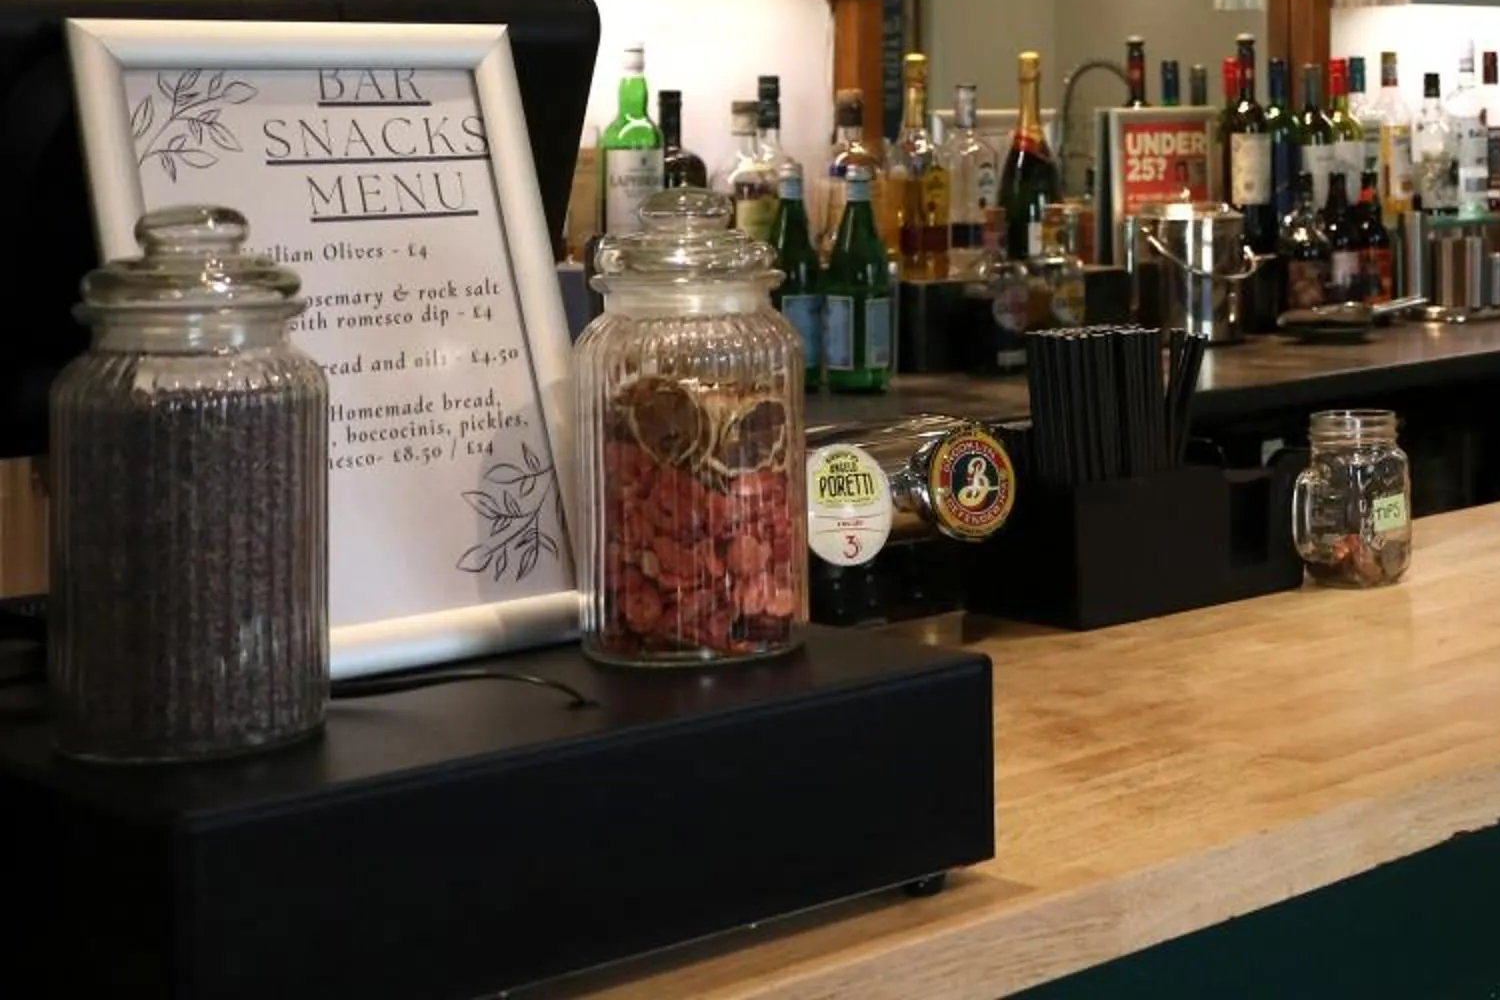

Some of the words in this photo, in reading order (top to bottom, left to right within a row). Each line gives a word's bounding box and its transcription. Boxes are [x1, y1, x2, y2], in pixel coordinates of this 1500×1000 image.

[317, 67, 424, 103] BAR
[262, 115, 490, 160] SNACKS
[1125, 131, 1207, 157] UNDER
[1126, 156, 1168, 182] 25?
[306, 170, 466, 215] MENU
[322, 242, 384, 261] Olives
[407, 244, 428, 262] £4
[306, 288, 384, 311] osemary
[392, 283, 410, 302] &
[418, 279, 458, 300] rock
[465, 276, 501, 297] salt
[336, 310, 414, 328] romesco
[420, 303, 450, 328] dip
[472, 306, 493, 323] £4
[321, 354, 362, 377] ead
[370, 351, 406, 373] and
[471, 346, 519, 368] £4.50
[330, 394, 434, 423] Homemade
[329, 453, 384, 471] esco-
[393, 445, 443, 465] £8.50
[466, 440, 494, 457] £14
[818, 472, 875, 499] PORETTI
[843, 534, 860, 560] 3
